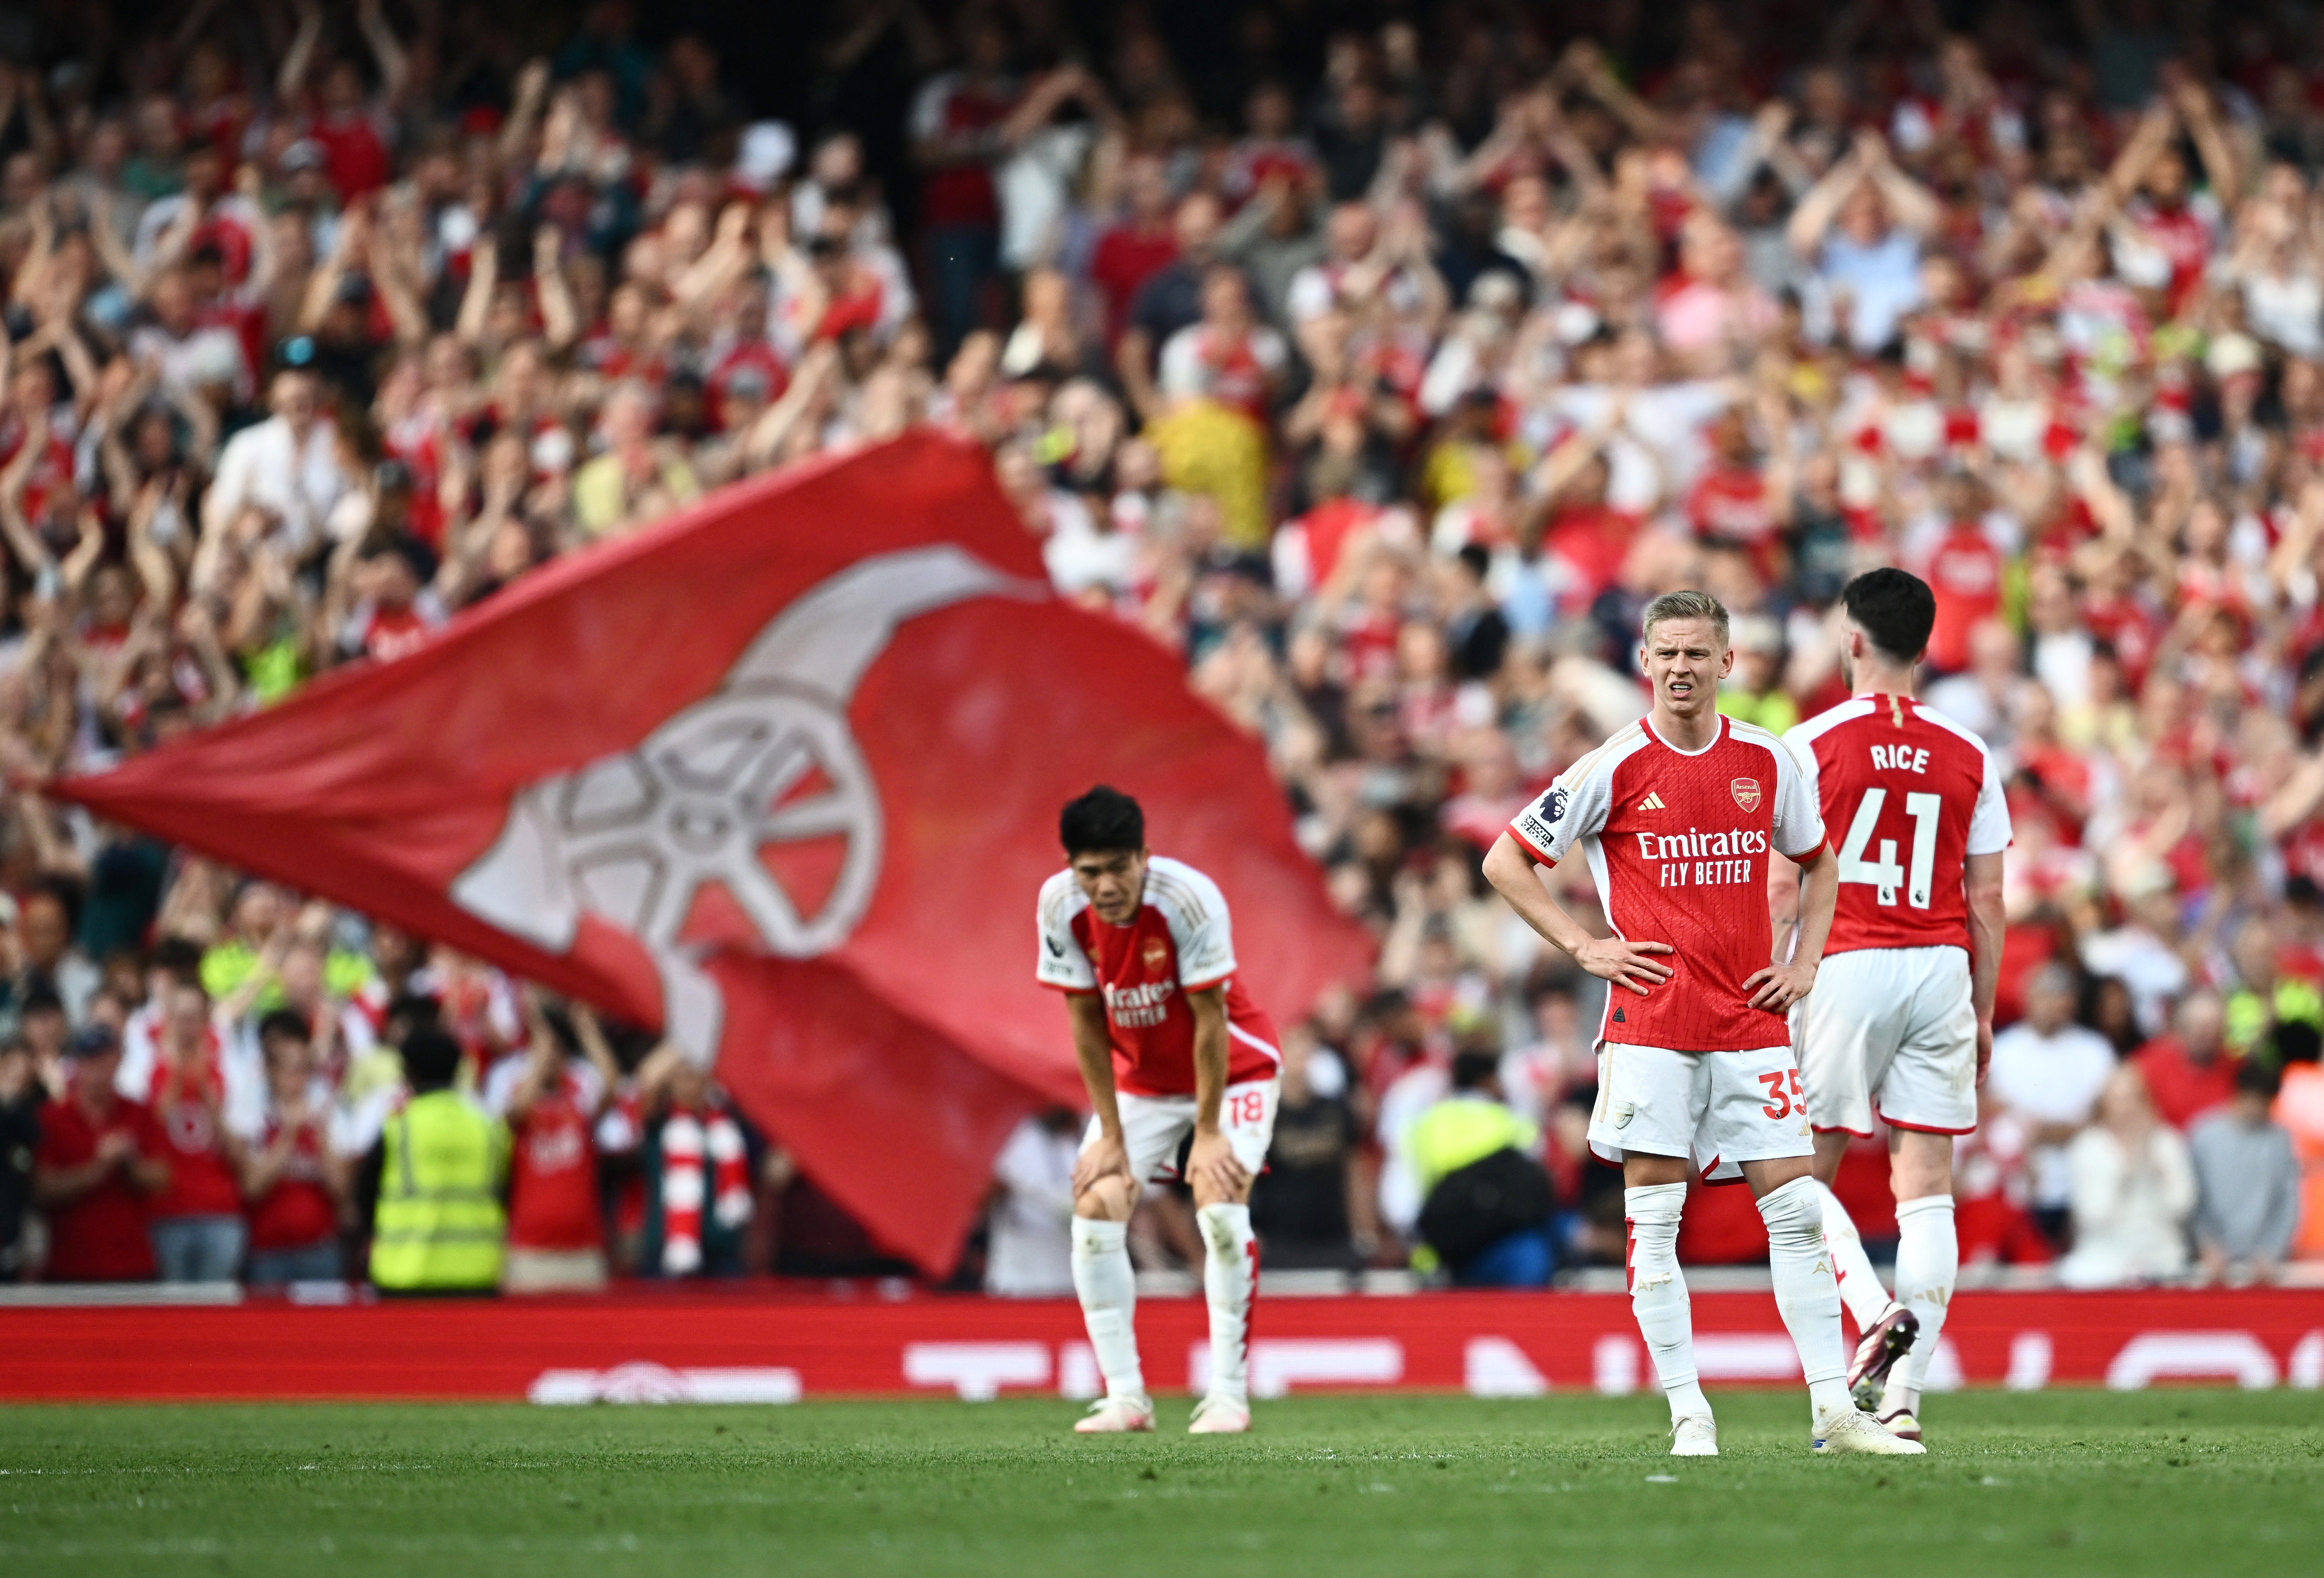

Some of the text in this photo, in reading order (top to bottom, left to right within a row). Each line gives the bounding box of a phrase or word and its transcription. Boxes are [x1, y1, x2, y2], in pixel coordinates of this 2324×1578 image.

[1870, 744, 1930, 774] RICE
[1524, 814, 1551, 841] No room
[1528, 827, 1549, 848] racism
[1638, 827, 1766, 860] Emirates
[1838, 787, 1941, 910] 41
[1661, 859, 1751, 887] FLY BETTER
[1758, 1068, 1807, 1120] 35
[1229, 1092, 1263, 1129] 18
[1636, 1271, 1672, 1293] AFC
